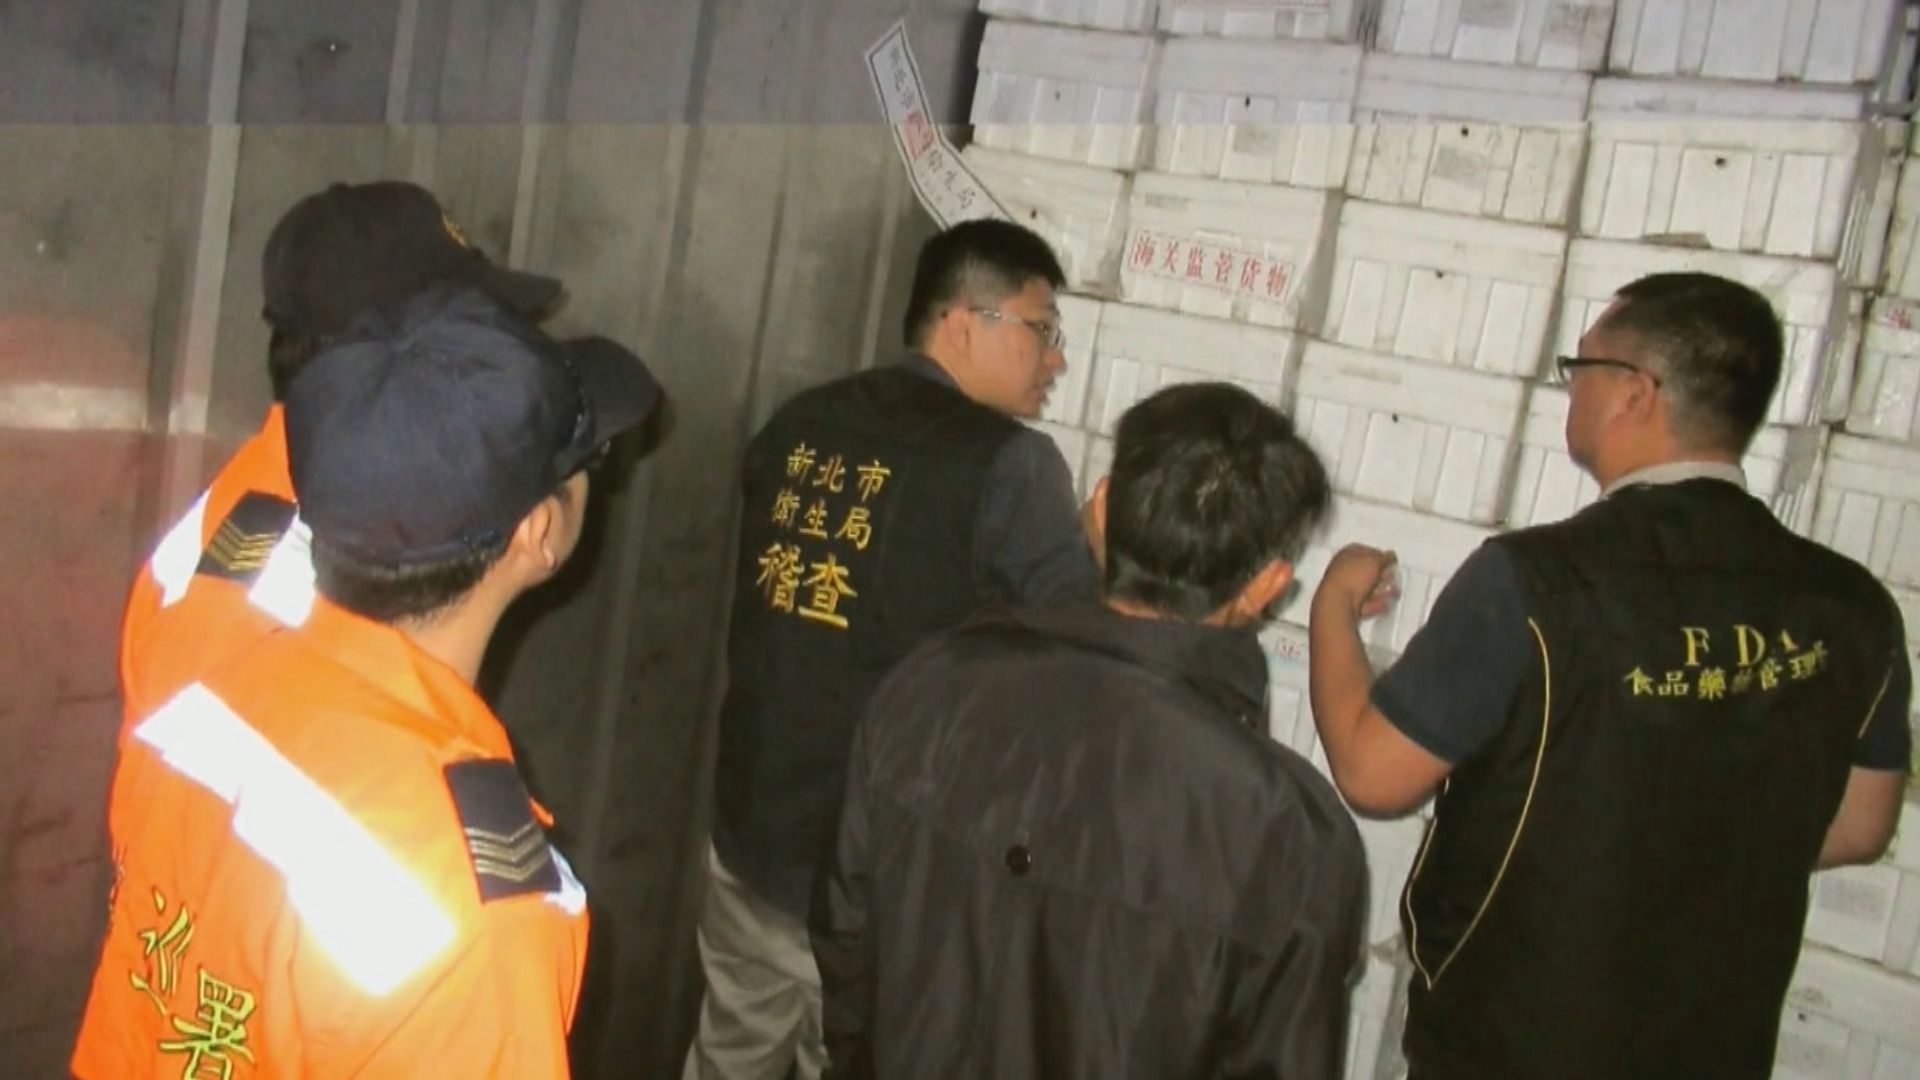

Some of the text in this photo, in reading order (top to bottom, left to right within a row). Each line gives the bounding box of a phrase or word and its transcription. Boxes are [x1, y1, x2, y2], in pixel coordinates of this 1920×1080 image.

[1133, 231, 1289, 299] 海关监管货物
[786, 441, 893, 503] 新北市
[771, 486, 873, 552] 衛生局
[755, 541, 860, 630] 稽查
[116, 864, 257, 1080] 巡署
